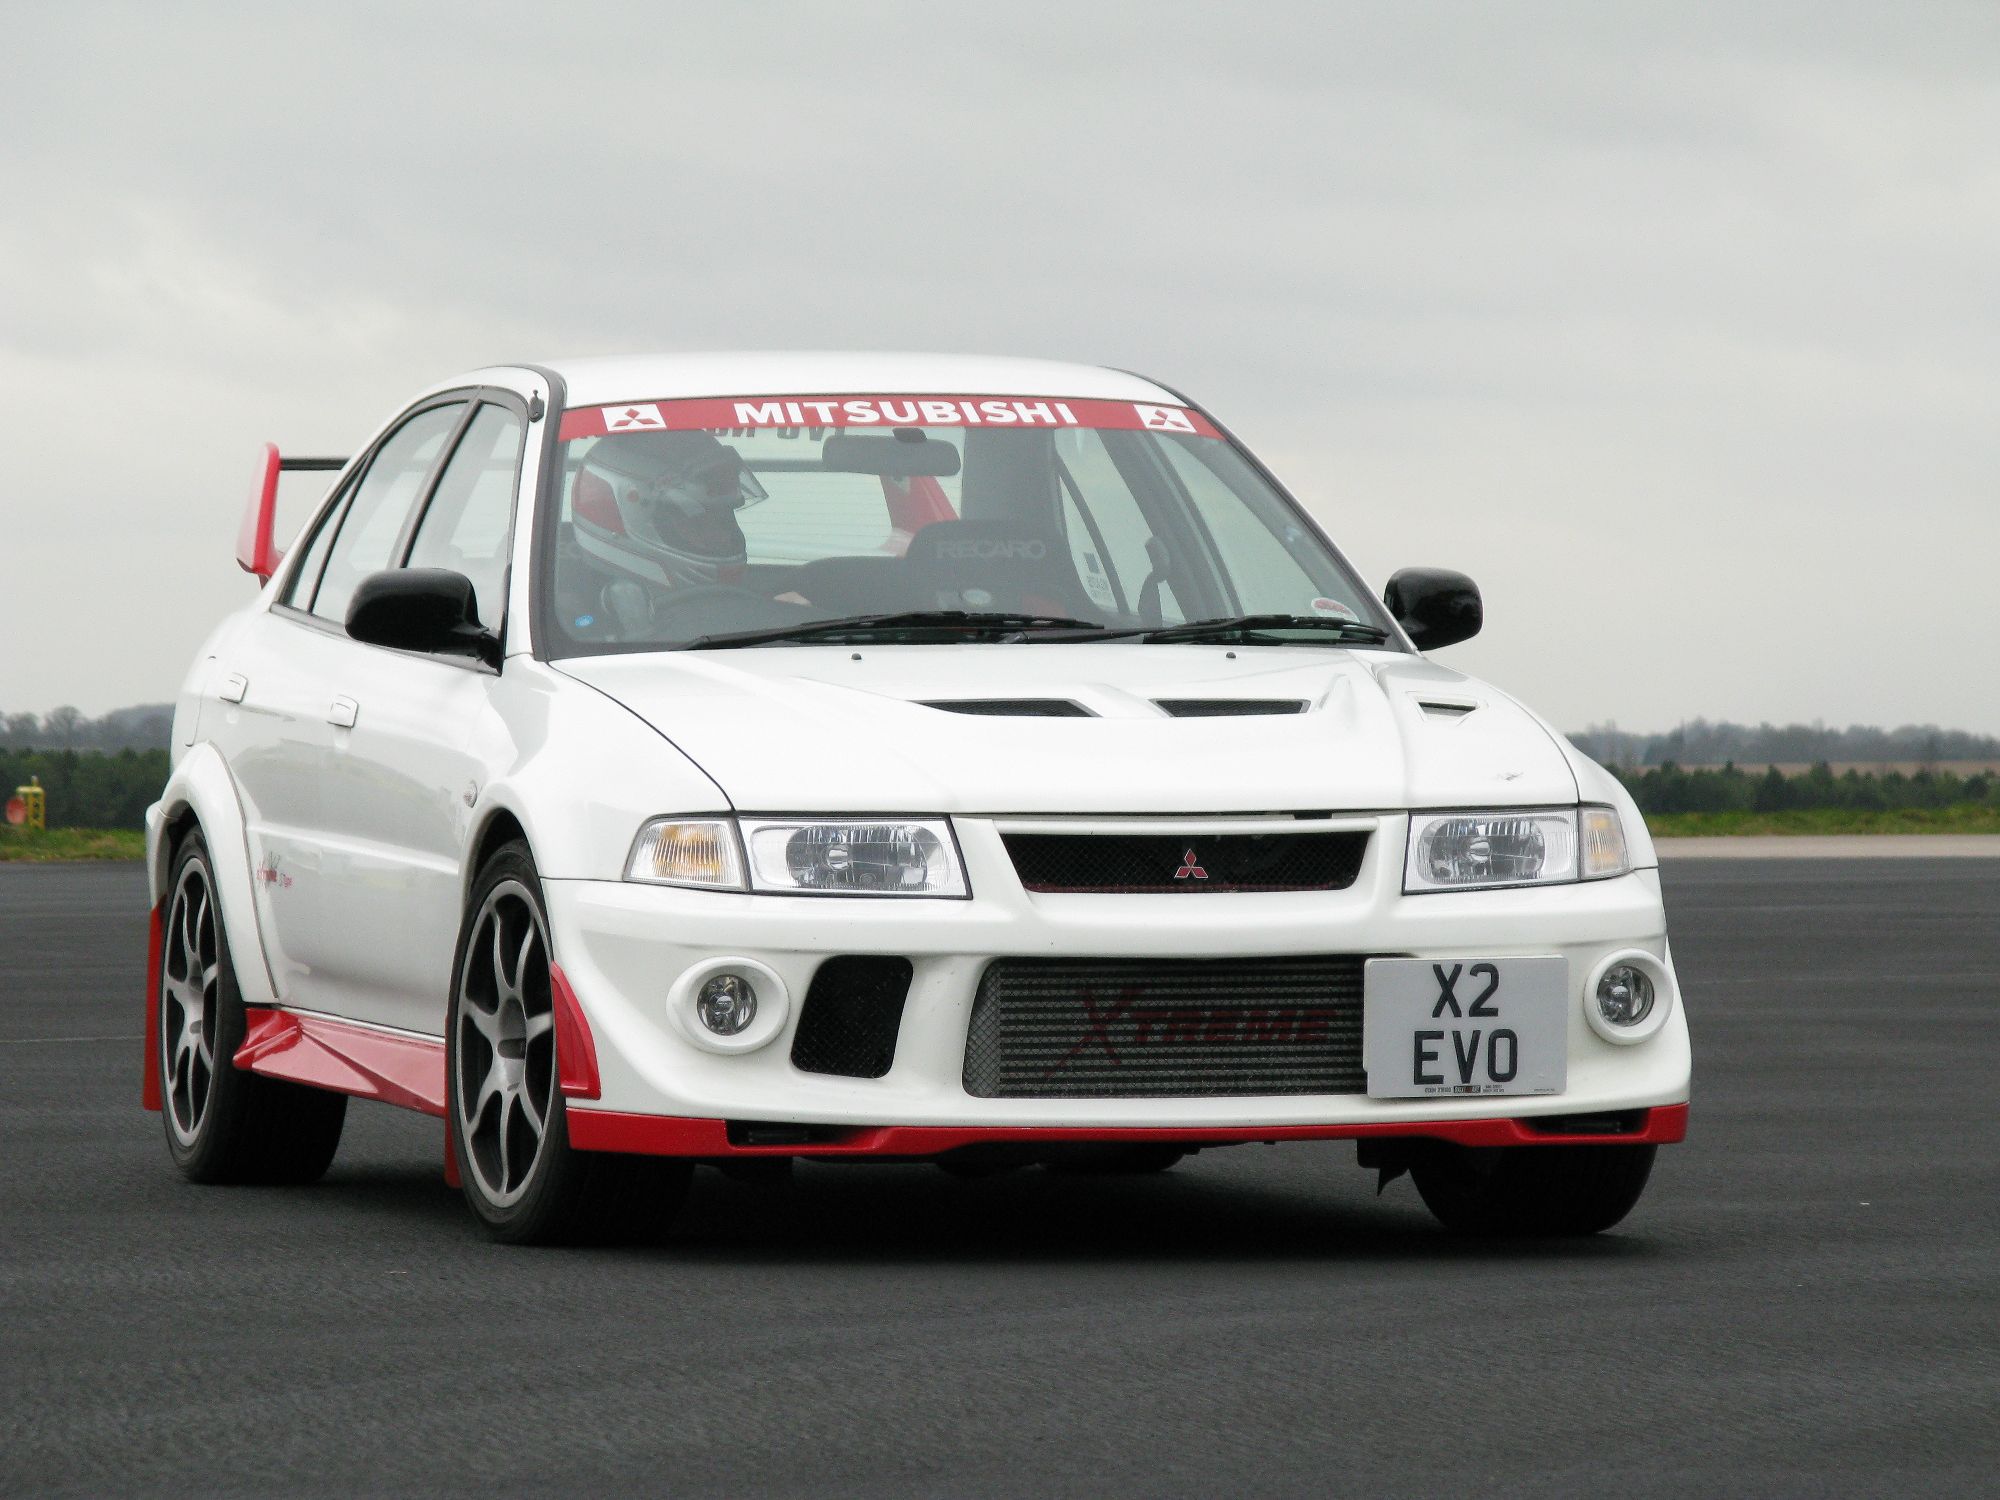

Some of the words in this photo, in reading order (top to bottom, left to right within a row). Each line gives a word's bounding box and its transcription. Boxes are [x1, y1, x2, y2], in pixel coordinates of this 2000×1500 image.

[733, 400, 1079, 424] MITSUBISHI
[935, 539, 1046, 560] RECARO
[1430, 963, 1500, 1018] X2
[1413, 1028, 1518, 1085] EVO
